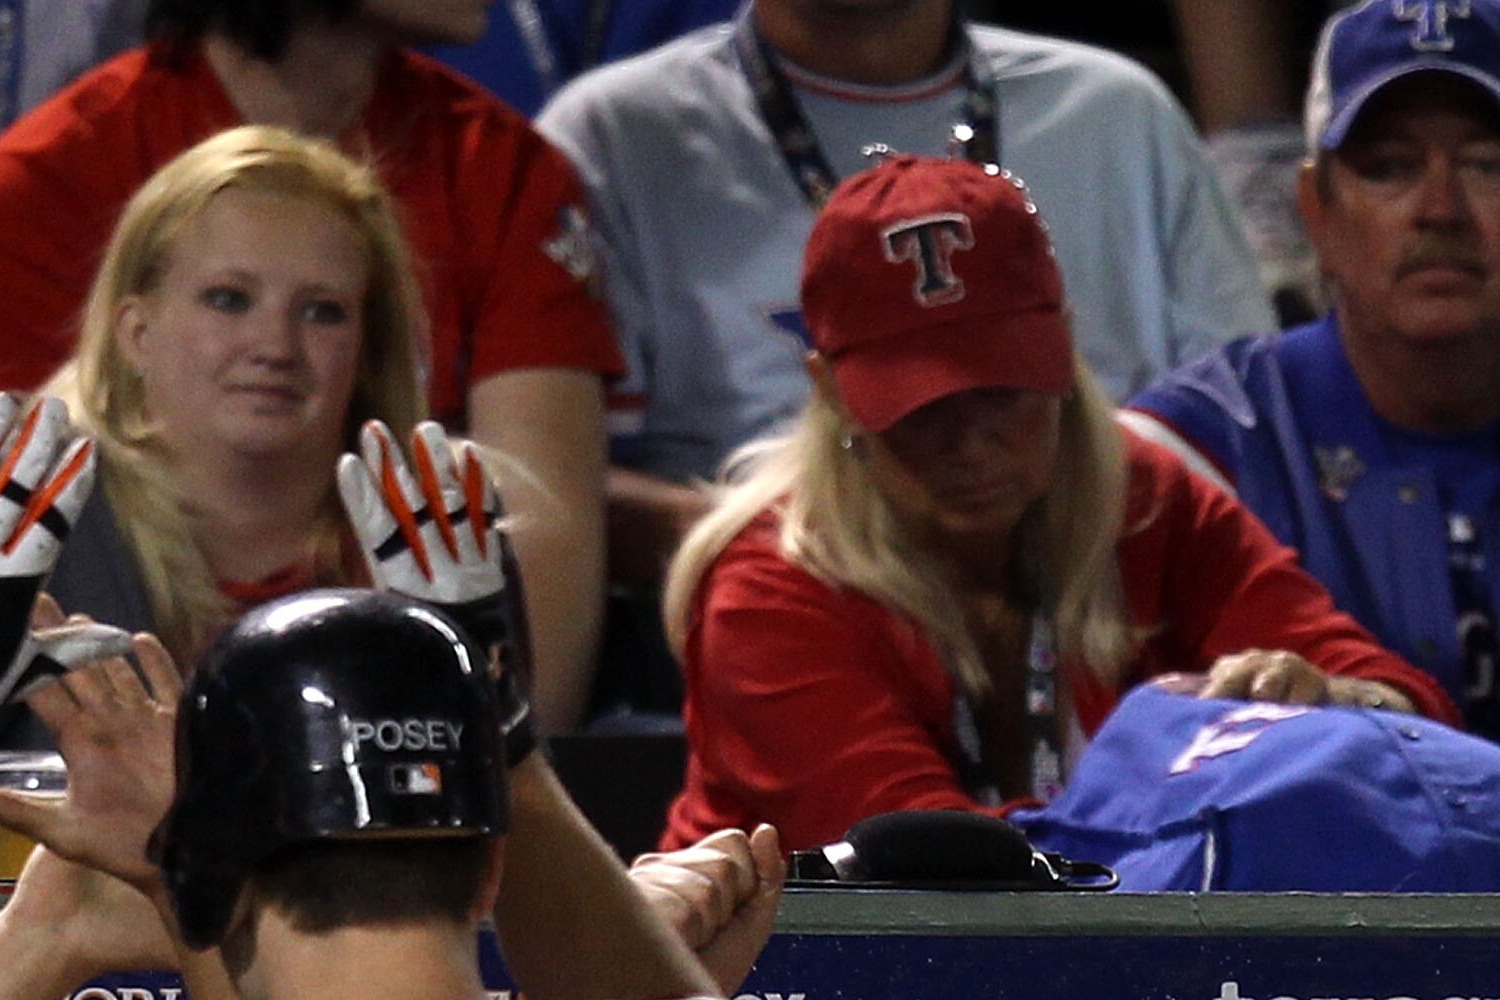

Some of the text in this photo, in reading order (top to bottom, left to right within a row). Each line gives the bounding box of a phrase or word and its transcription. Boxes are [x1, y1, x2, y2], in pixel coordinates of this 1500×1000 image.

[1392, 0, 1471, 51] T
[882, 211, 975, 307] T
[351, 719, 464, 751] POSEY
